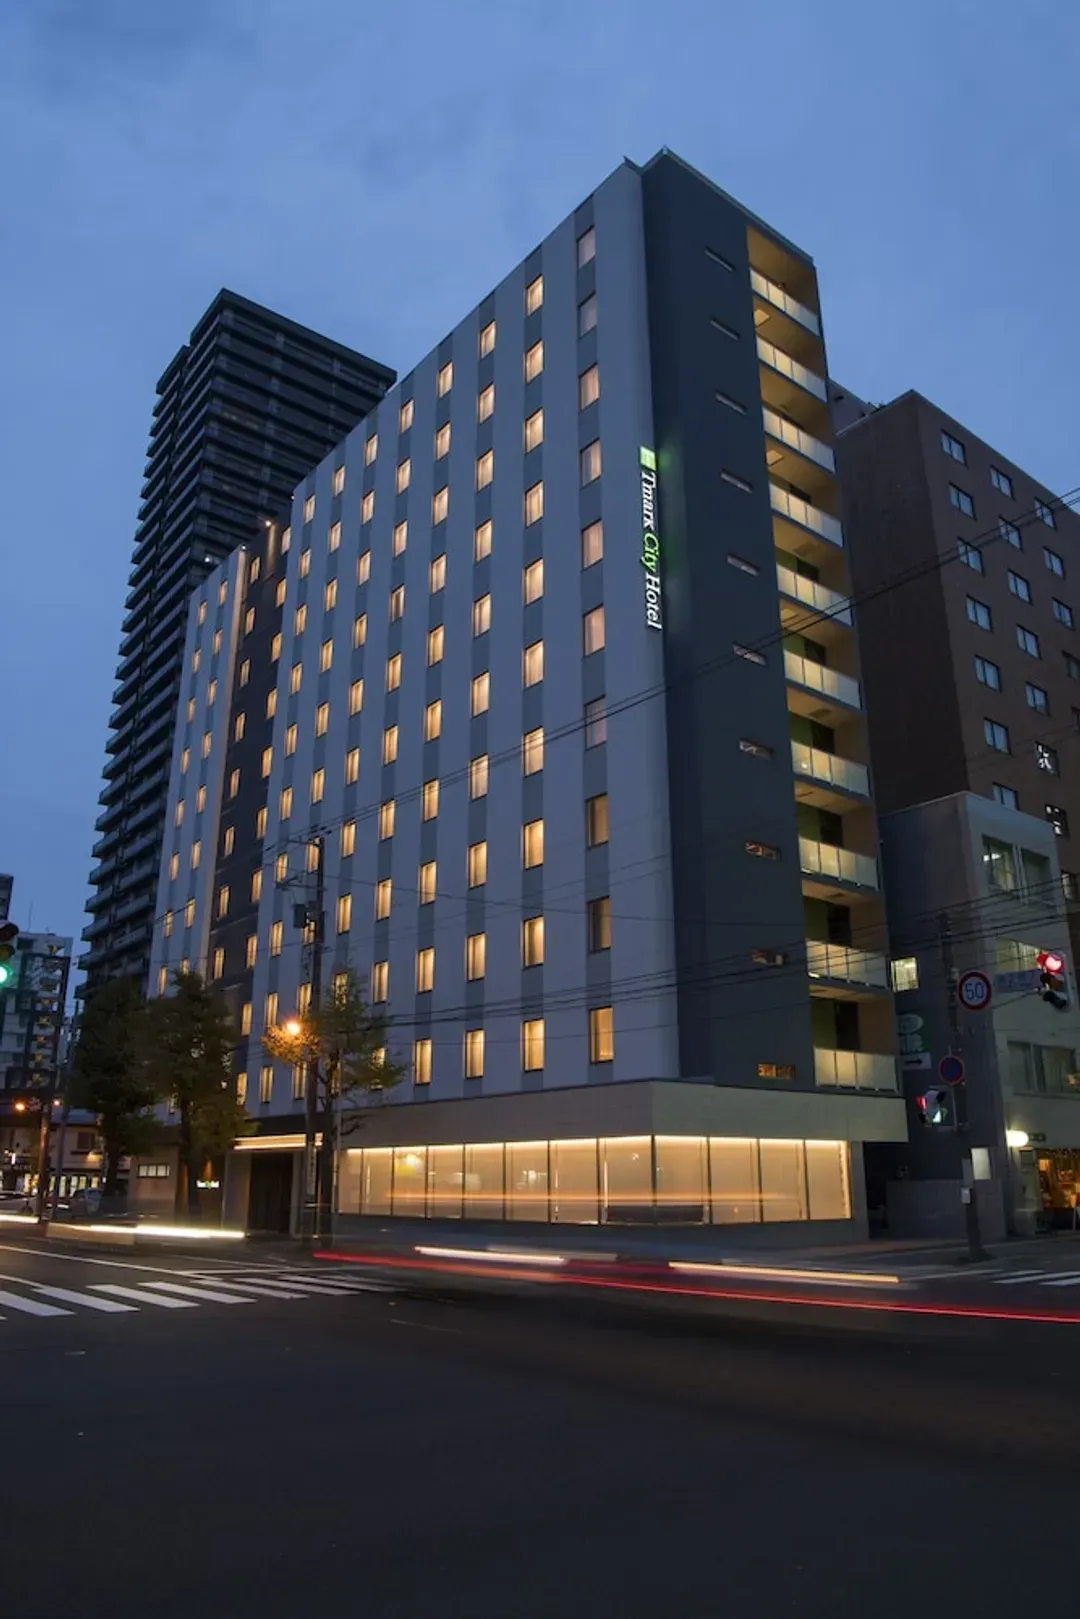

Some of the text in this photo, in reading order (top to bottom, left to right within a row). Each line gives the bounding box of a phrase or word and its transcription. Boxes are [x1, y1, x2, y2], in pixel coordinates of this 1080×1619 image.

[641, 471, 662, 629] Tmark City Hotel
[965, 982, 984, 1000] 50
